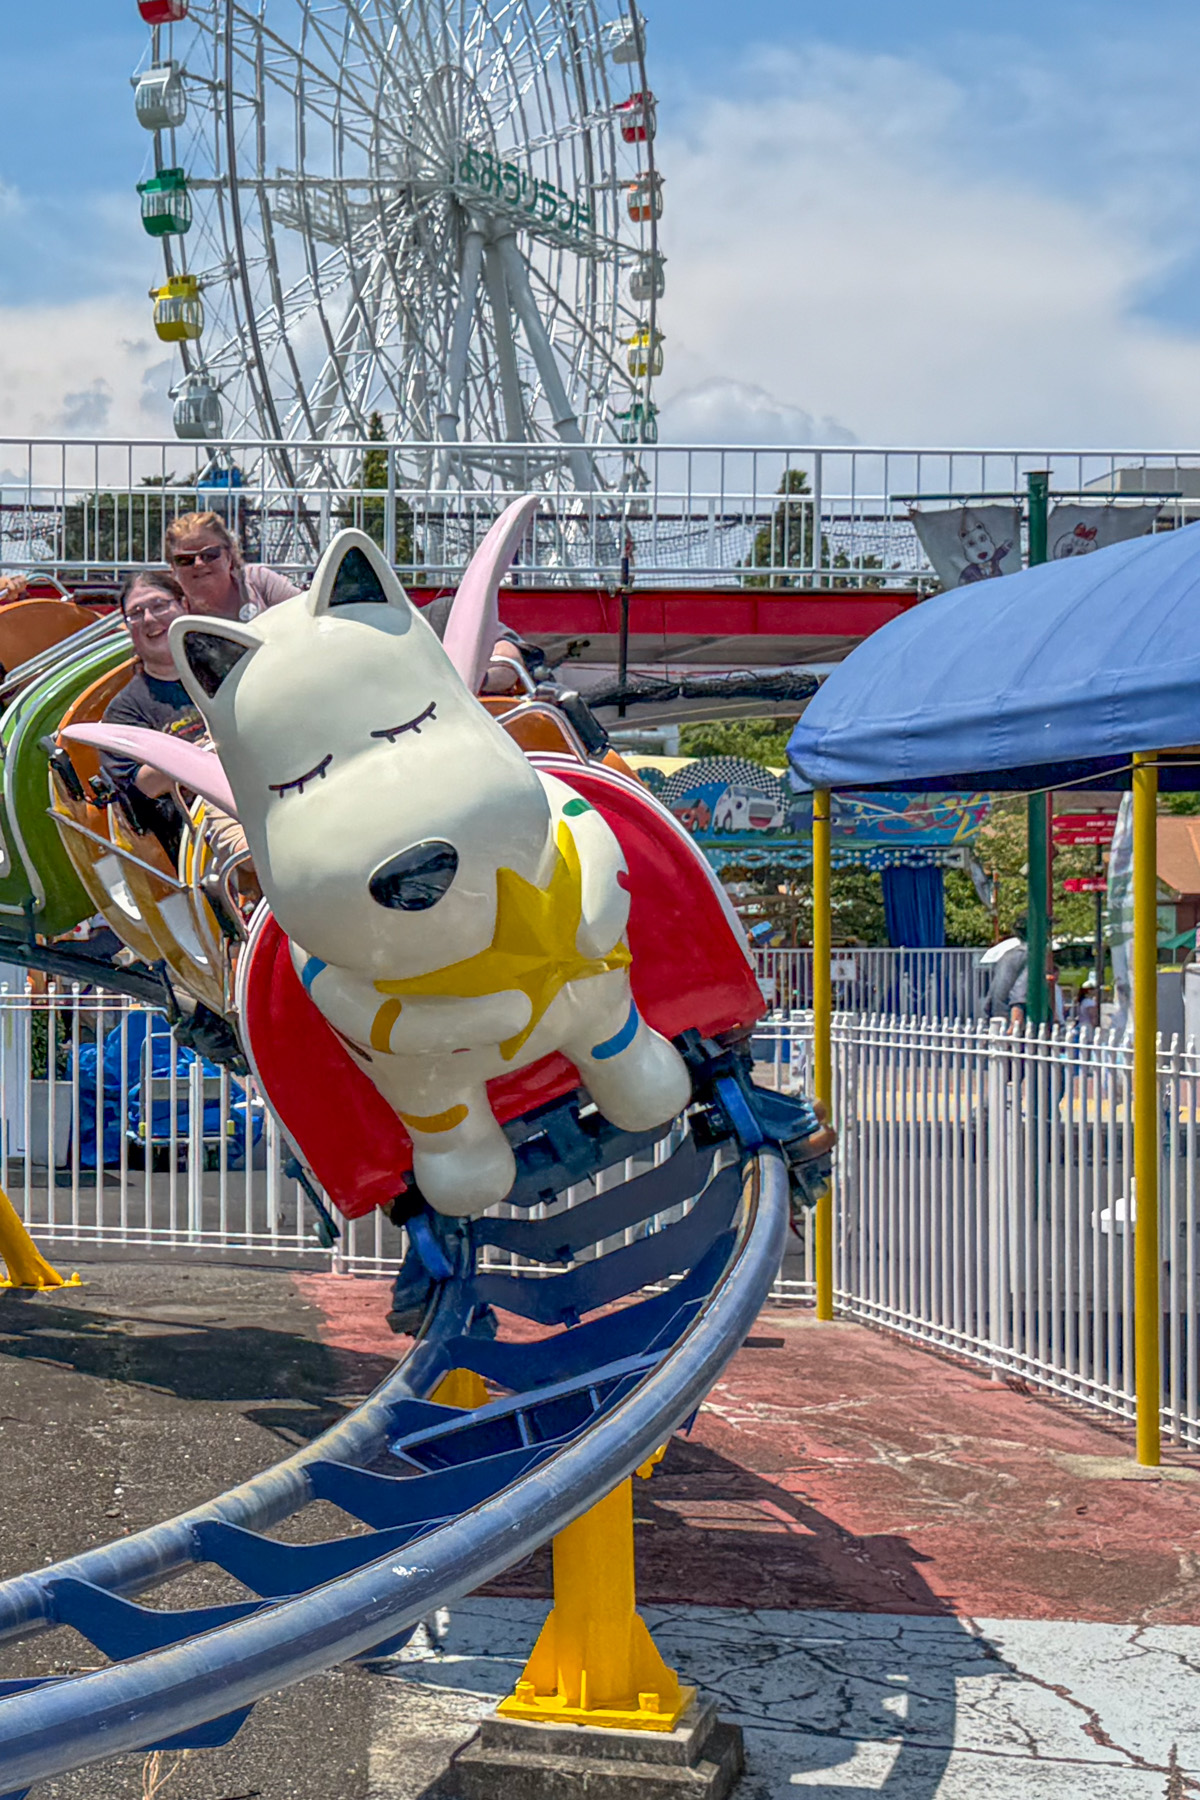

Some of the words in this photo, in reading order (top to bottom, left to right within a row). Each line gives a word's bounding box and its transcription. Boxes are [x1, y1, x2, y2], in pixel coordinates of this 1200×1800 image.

[459, 143, 590, 237] よみうりランド
